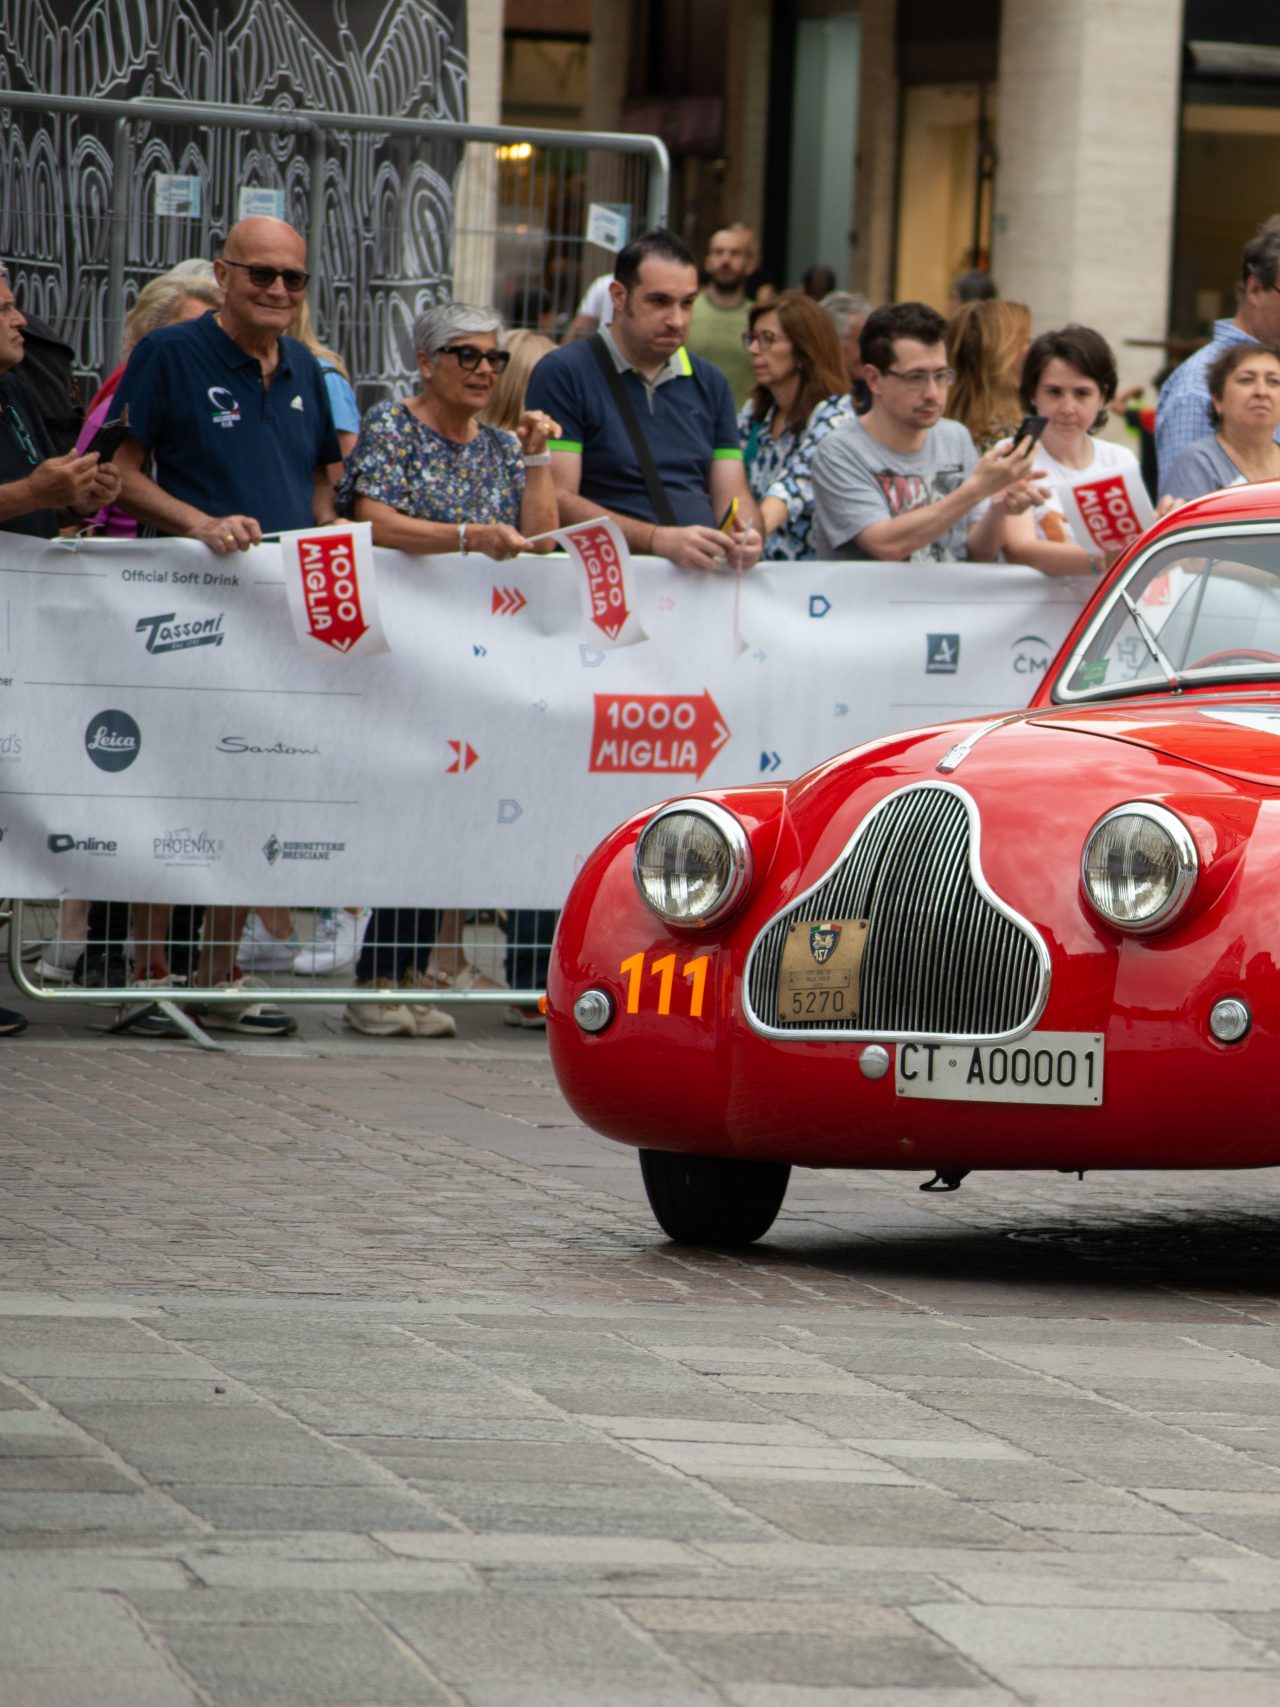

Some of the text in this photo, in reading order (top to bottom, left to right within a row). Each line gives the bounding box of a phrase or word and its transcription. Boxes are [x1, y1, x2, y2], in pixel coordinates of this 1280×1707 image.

[121, 569, 240, 586] Official Soft Drink
[329, 544, 357, 622] 1000
[572, 535, 608, 616] MIGLIA
[595, 533, 622, 607] 1000
[302, 543, 333, 631] MIGLIA
[135, 612, 225, 654] Tassoni
[607, 701, 696, 730] 1000
[87, 726, 137, 752] Leica
[215, 736, 321, 755] Santoni
[595, 740, 697, 768] MIGLIA
[47, 833, 118, 854] Online
[153, 837, 216, 854] PHOENIX
[282, 850, 330, 861] BRESCIANE
[620, 952, 709, 1017] 111
[792, 990, 844, 1015] 5270
[900, 1043, 1095, 1088] CT A00001
